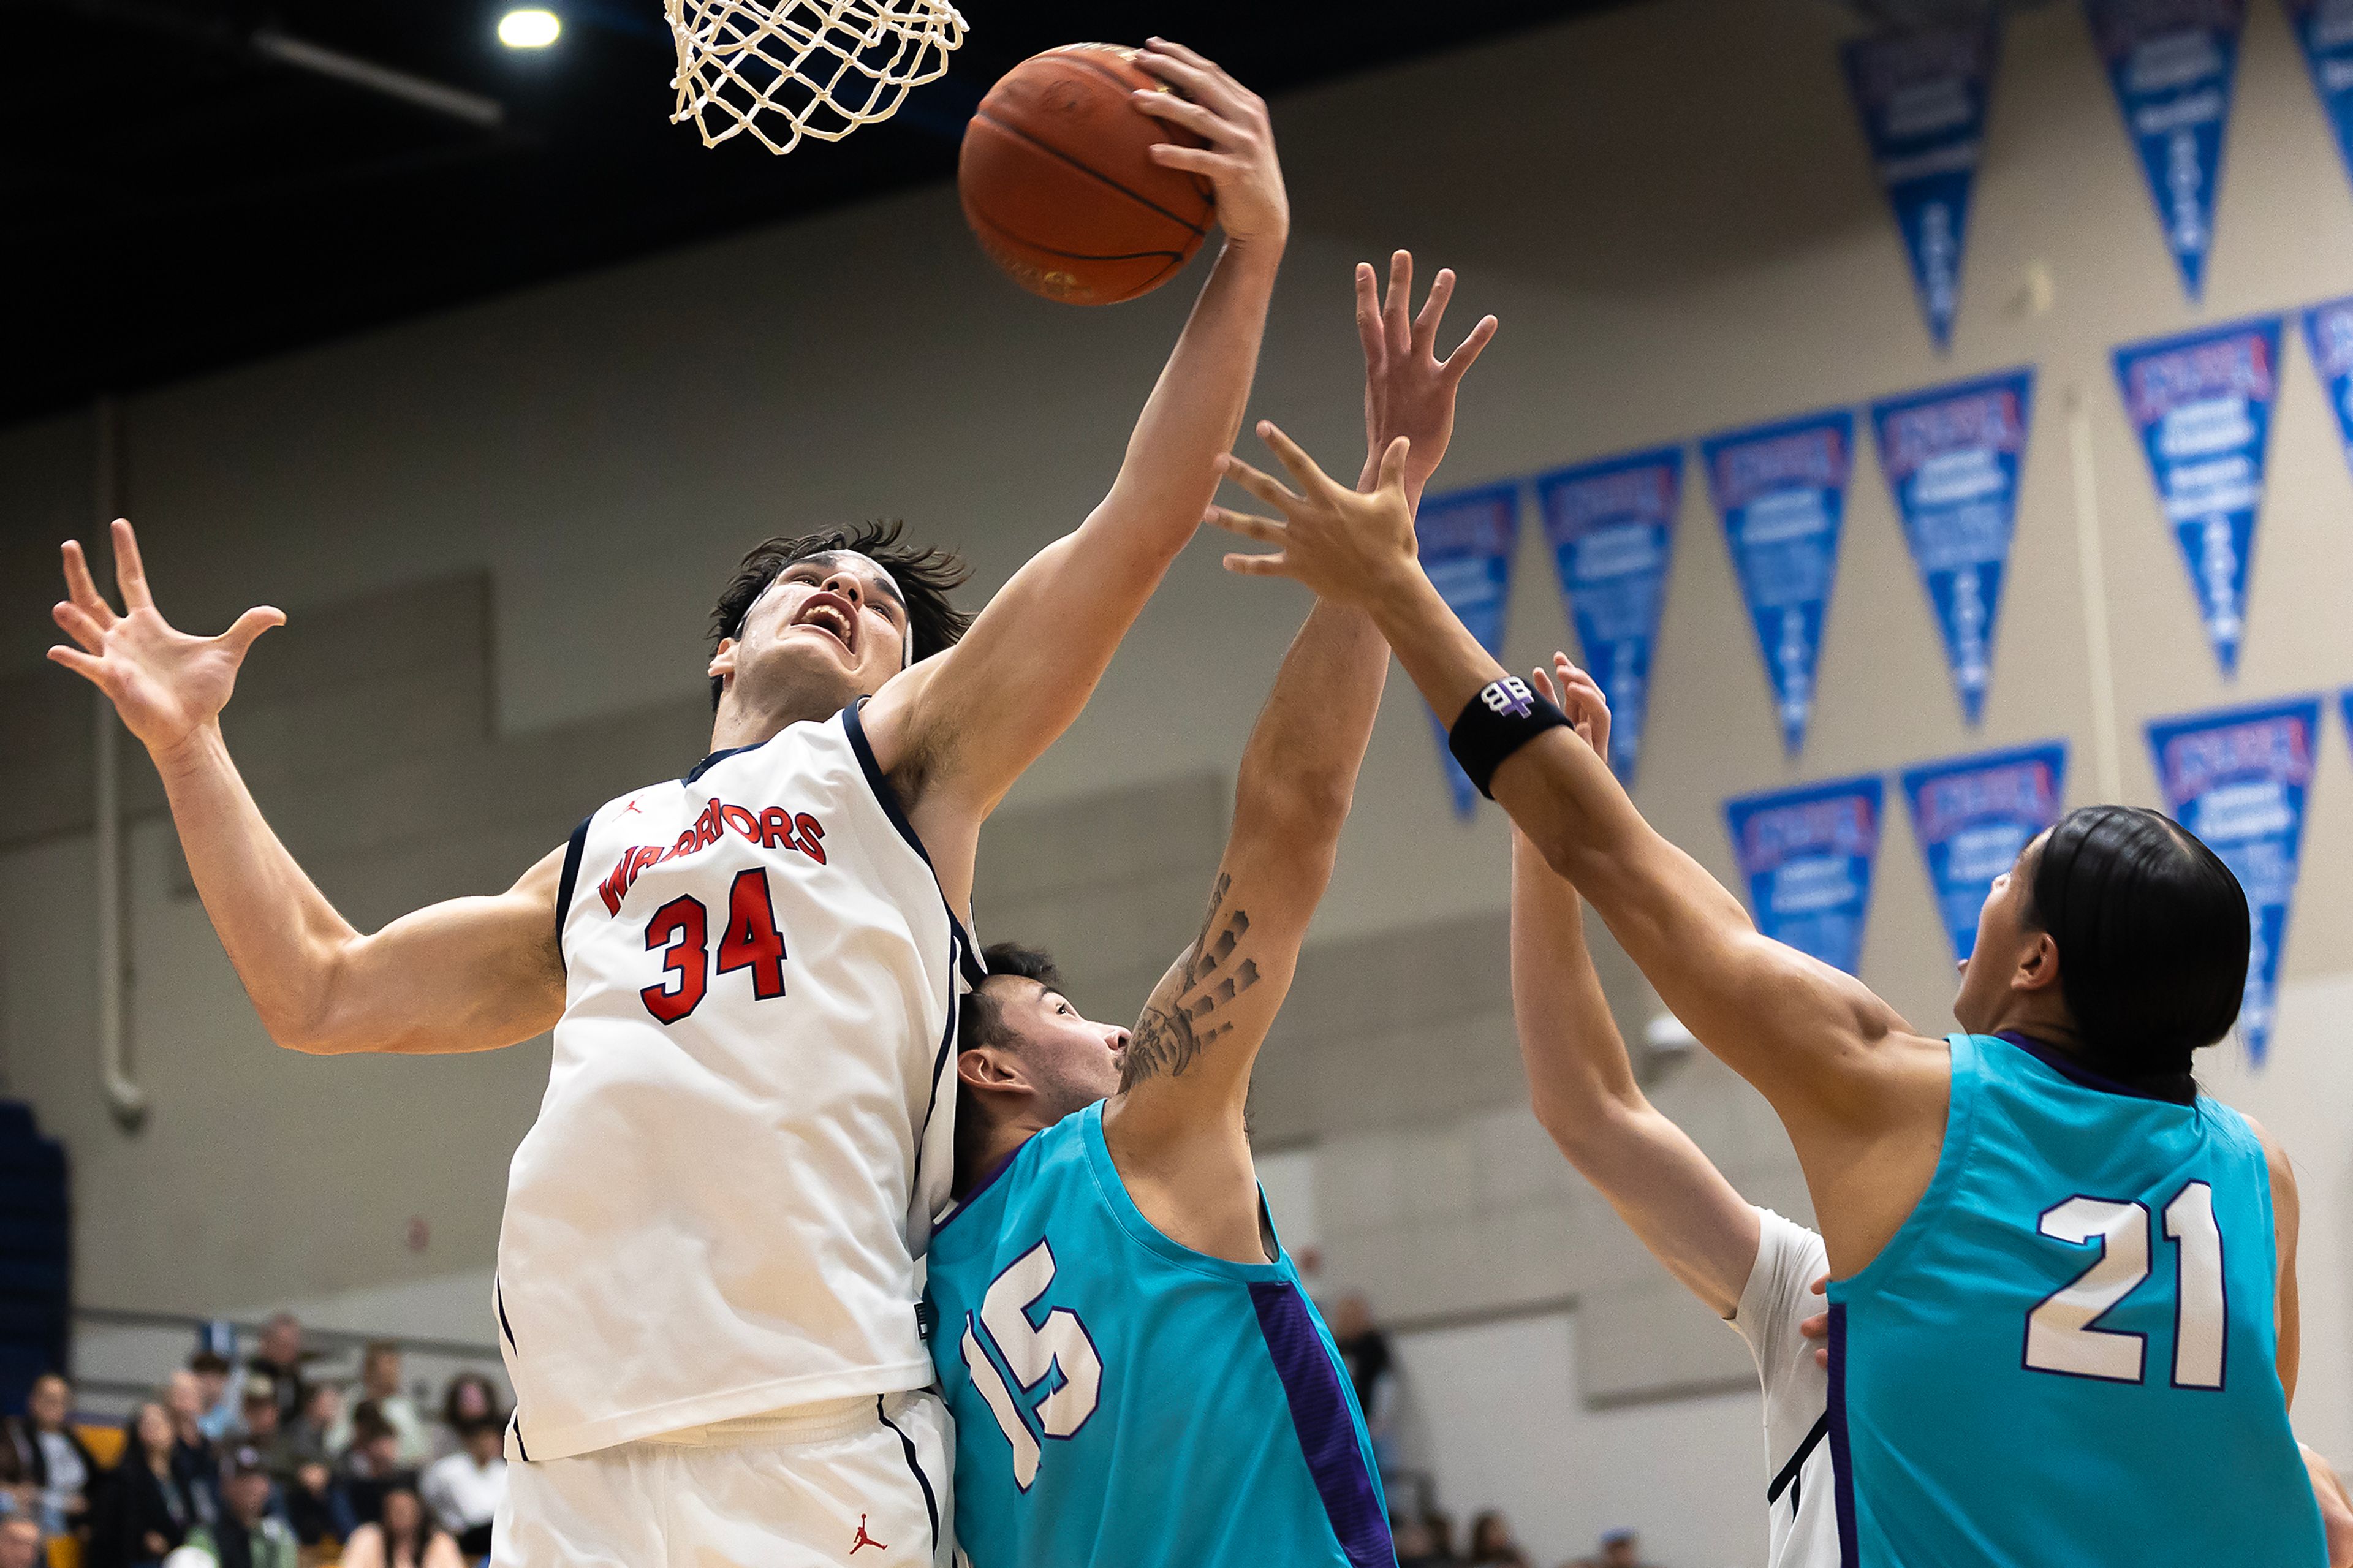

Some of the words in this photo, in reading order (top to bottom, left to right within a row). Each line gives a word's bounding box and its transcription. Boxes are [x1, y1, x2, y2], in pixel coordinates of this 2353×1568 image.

[599, 798, 826, 918] WARRIORS
[640, 866, 787, 1026] 34
[960, 1236, 1103, 1494] 15
[2022, 1178, 2227, 1391] 21
